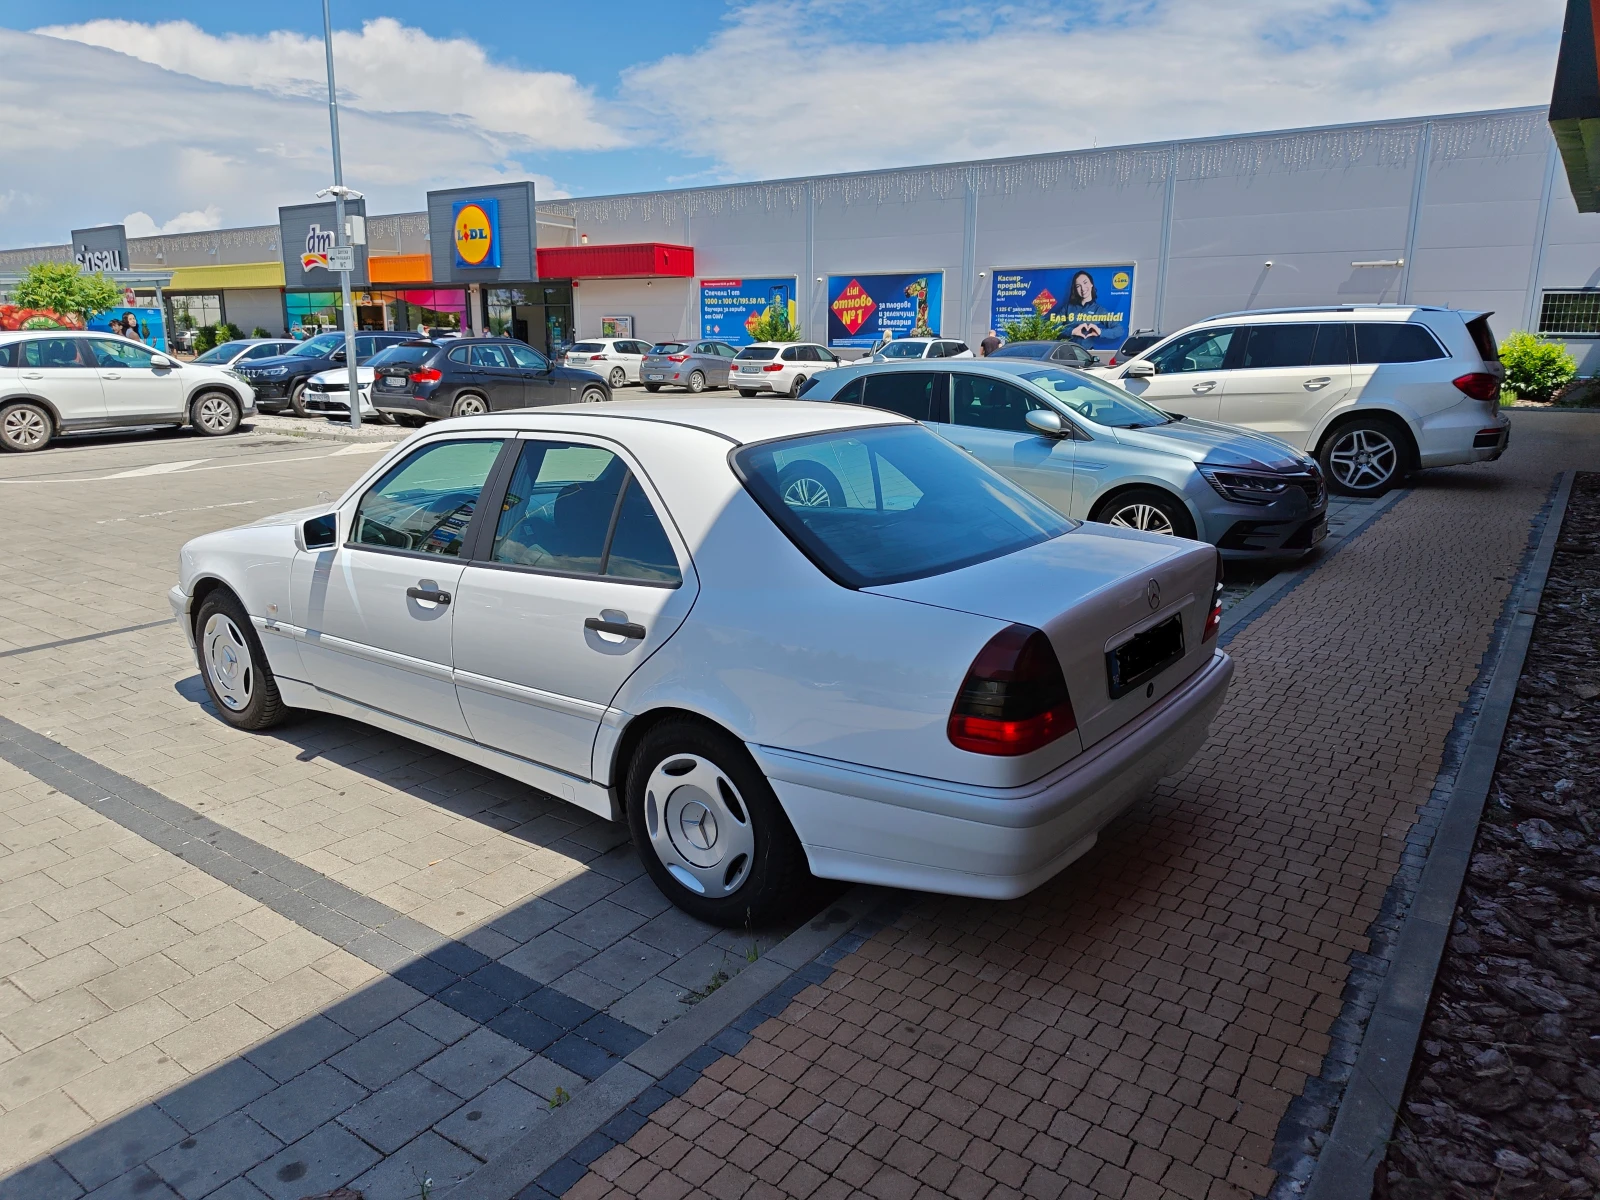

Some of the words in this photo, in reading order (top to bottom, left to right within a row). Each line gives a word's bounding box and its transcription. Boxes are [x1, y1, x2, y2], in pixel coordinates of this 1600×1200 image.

[307, 227, 331, 253] dm
[847, 286, 859, 296] Lidl
[833, 294, 873, 310] отново
[878, 302, 886, 310] за
[886, 301, 911, 309] плодове
[883, 310, 915, 318] зеленчуци
[1050, 312, 1066, 322] Ела
[1076, 312, 1124, 322] #teamlidl
[883, 318, 912, 327] България
